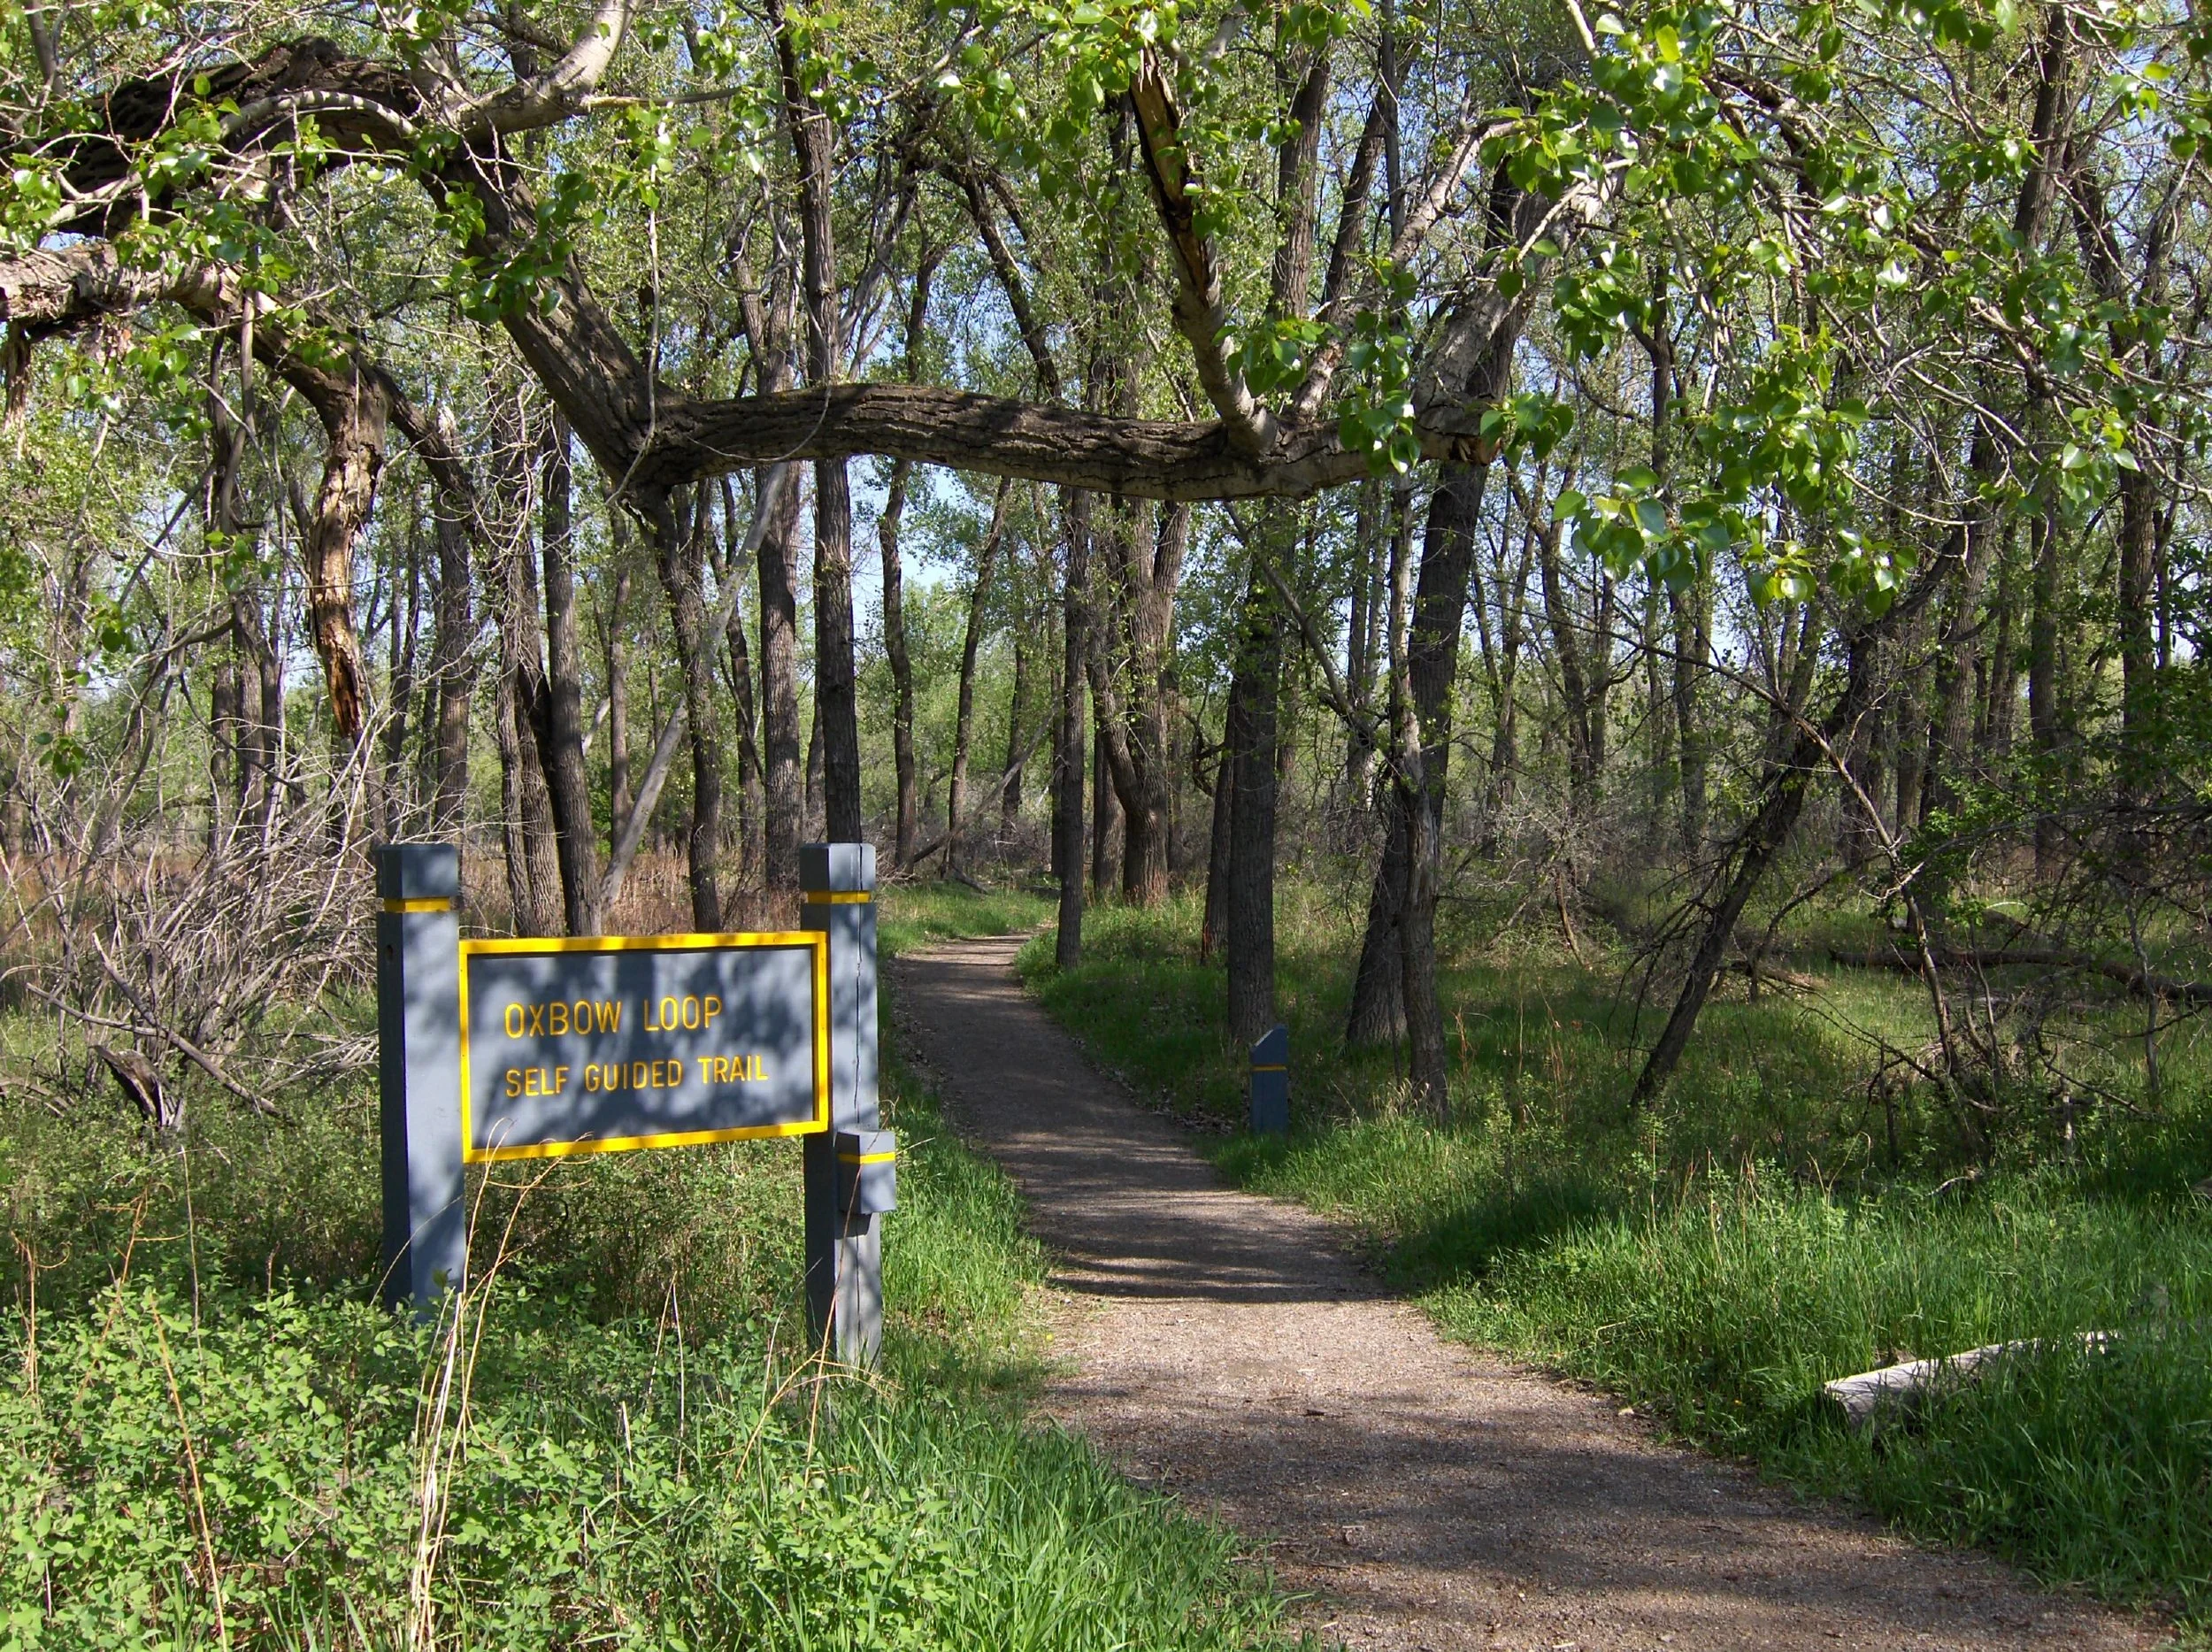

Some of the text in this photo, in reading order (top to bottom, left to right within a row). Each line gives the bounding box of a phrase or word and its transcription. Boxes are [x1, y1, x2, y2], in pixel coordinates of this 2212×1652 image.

[503, 994, 723, 1039] OXBOW LOOP
[504, 1054, 769, 1098] SELF GUIDED TRAIL
